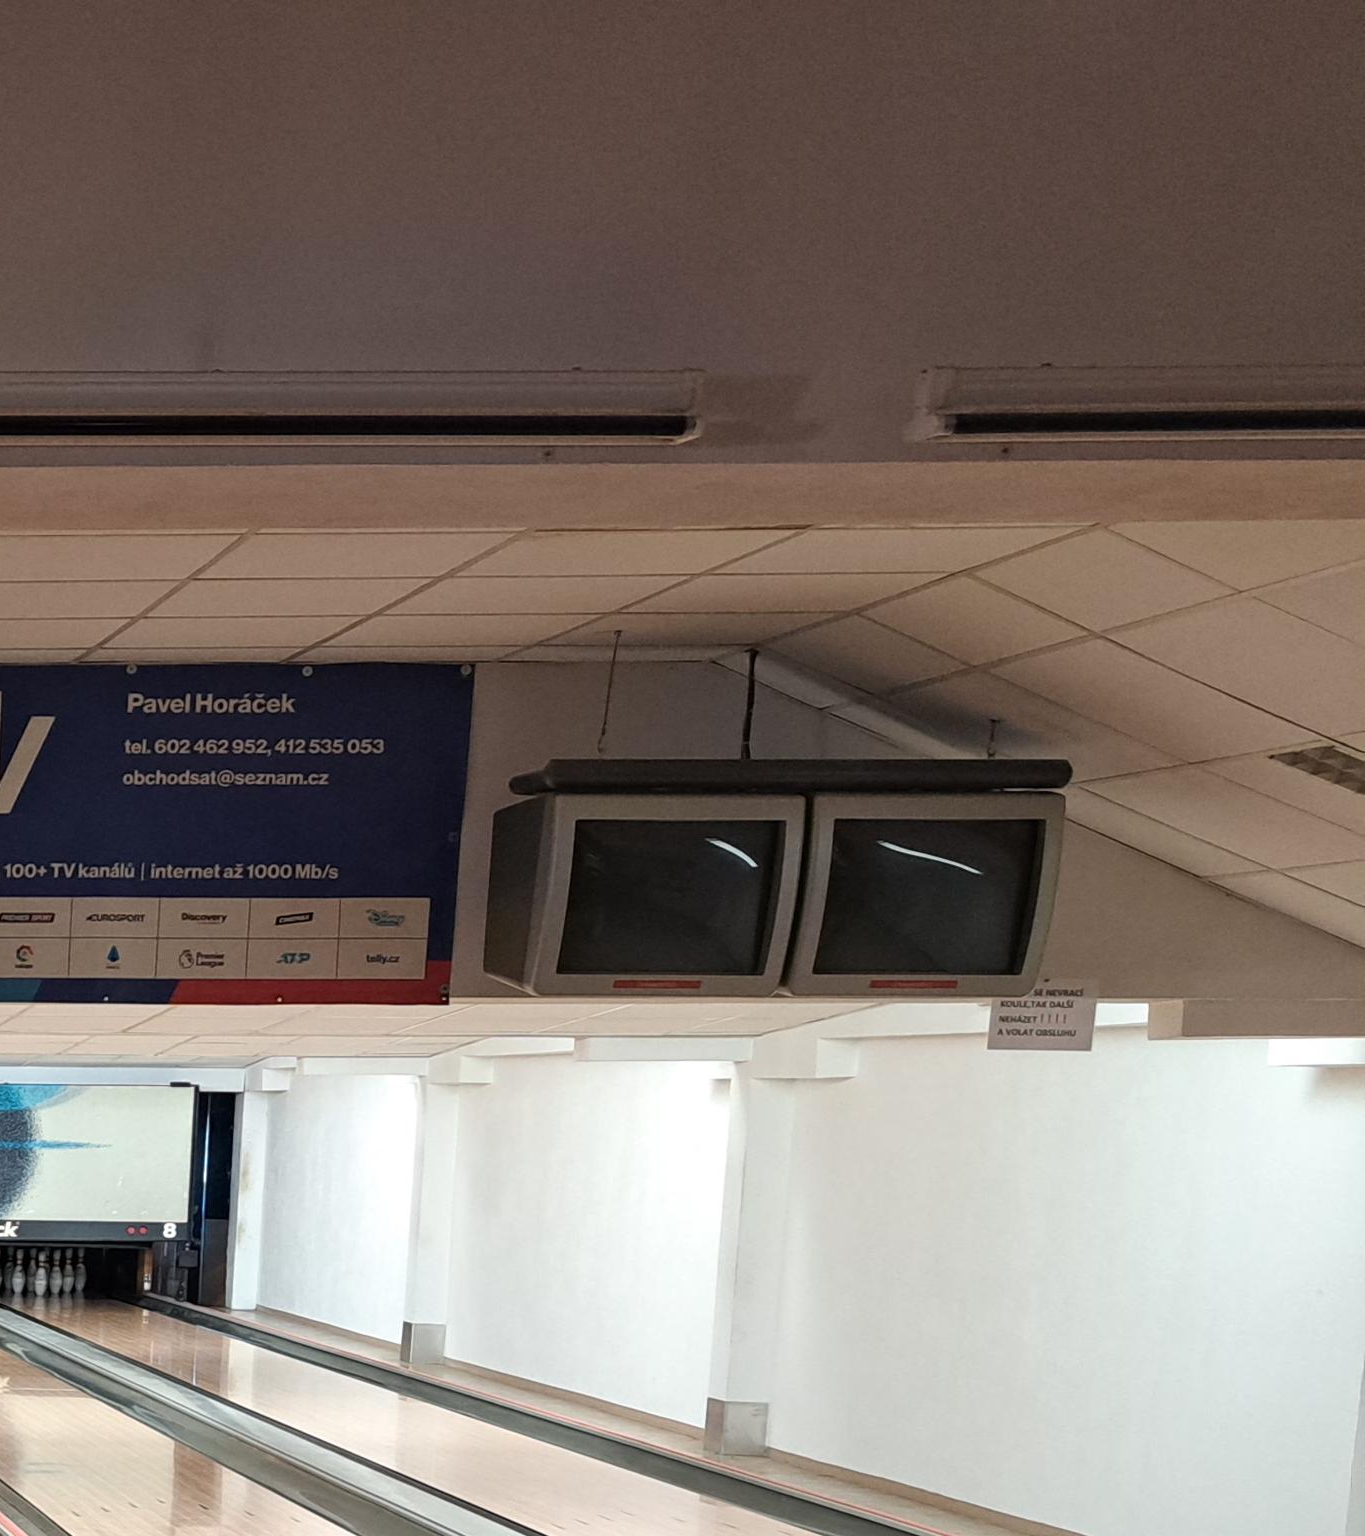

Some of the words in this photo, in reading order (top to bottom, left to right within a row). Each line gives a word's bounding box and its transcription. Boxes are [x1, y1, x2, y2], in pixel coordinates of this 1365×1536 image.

[127, 693, 191, 713] Pavel
[195, 693, 296, 714] Horáček
[124, 739, 151, 754] tel.
[154, 739, 191, 754] 602
[193, 739, 229, 754] 462
[232, 739, 271, 757] 952,
[274, 739, 306, 754] 412
[308, 739, 344, 754] 535
[347, 739, 385, 754] 053
[123, 770, 329, 787] obchodsat@seznam.cz
[4, 863, 47, 878] 100+
[51, 864, 77, 878] TV
[78, 863, 135, 879] kanálů
[150, 864, 220, 879] internet
[223, 864, 243, 879] až
[247, 864, 293, 879] 1000
[295, 863, 340, 880] Mb/s
[181, 912, 228, 923] Discovery
[366, 954, 400, 964] telly.cz
[1006, 1029, 1034, 1037] VOLAT
[163, 1223, 177, 1238] 8
